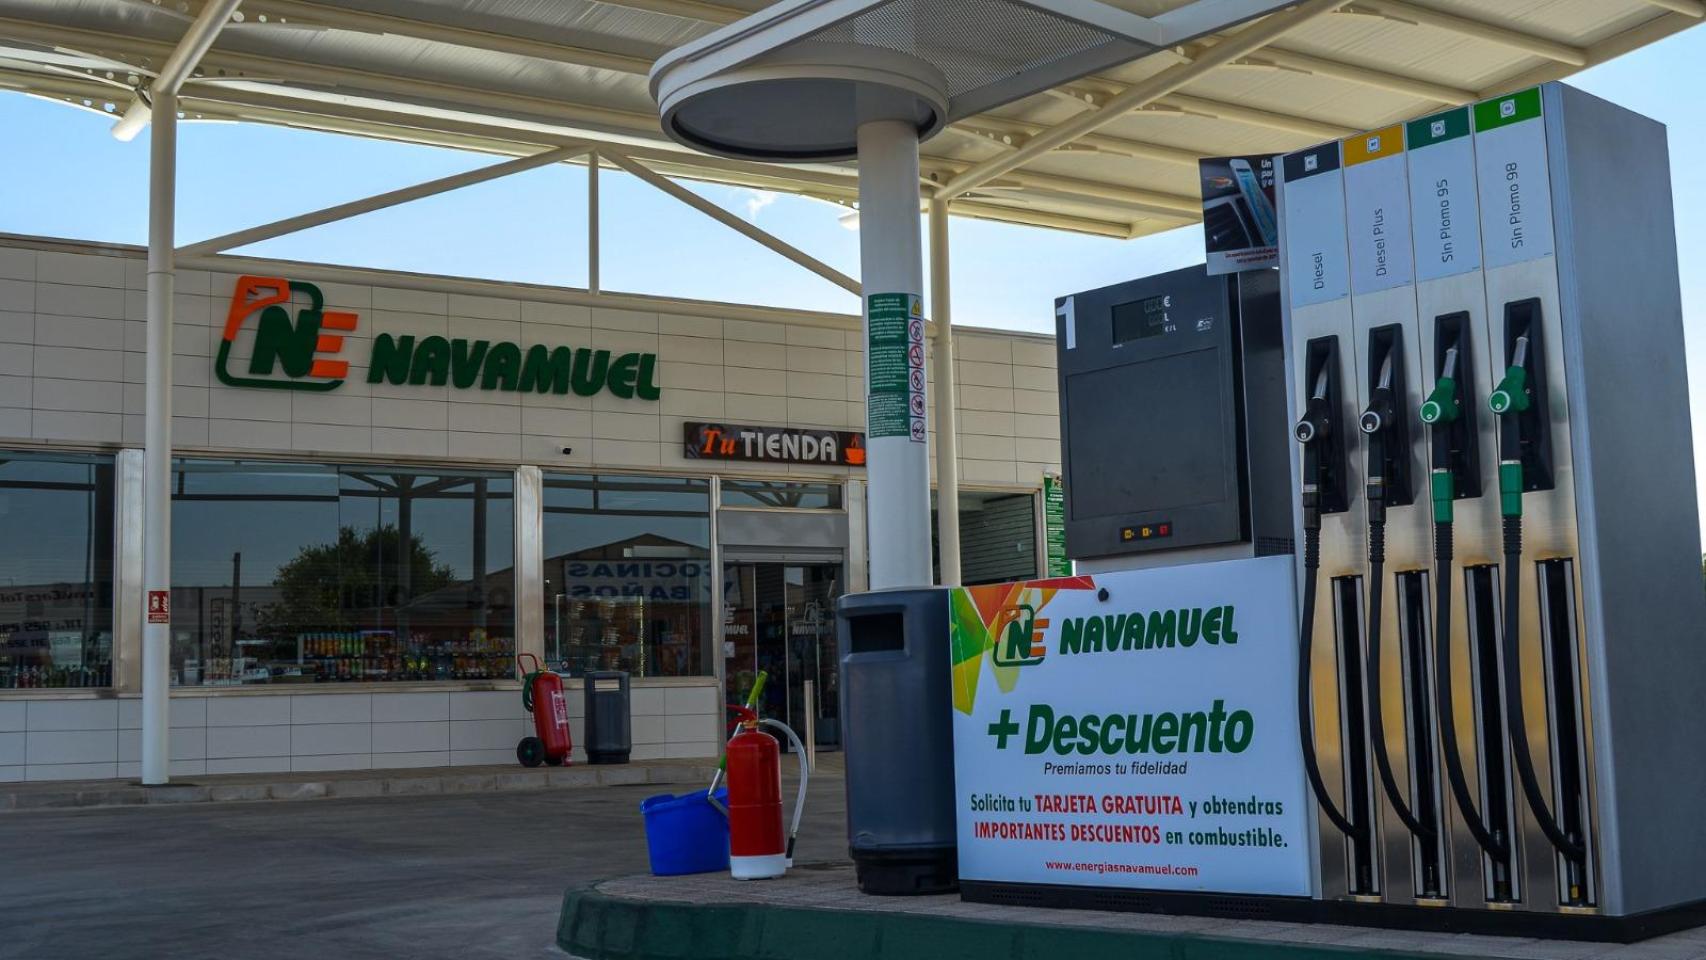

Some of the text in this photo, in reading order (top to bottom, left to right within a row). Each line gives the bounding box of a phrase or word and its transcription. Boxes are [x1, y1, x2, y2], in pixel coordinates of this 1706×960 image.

[1436, 178, 1453, 264] Sin Plomo 95
[1506, 162, 1524, 249] Sin Plomo 98
[1373, 208, 1387, 277] Diesel Plus
[1314, 252, 1324, 290] Diesel
[1056, 296, 1076, 349] 1
[367, 332, 661, 401] NAVAMUEL
[703, 429, 837, 461] Tu TIENDA
[725, 625, 749, 635] MUEL
[1060, 605, 1239, 655] NAVAMUEL
[1024, 699, 1254, 755] Descuento
[1044, 761, 1188, 776] Premiamos tu fidelidad
[971, 794, 1284, 818] Solicita tu TARJETA GRATUITA y obtendras
[974, 821, 1289, 848] IMPORTANTES DESCUENTOS en combustible.
[1045, 859, 1199, 877] www.energiasnavamuel.com
